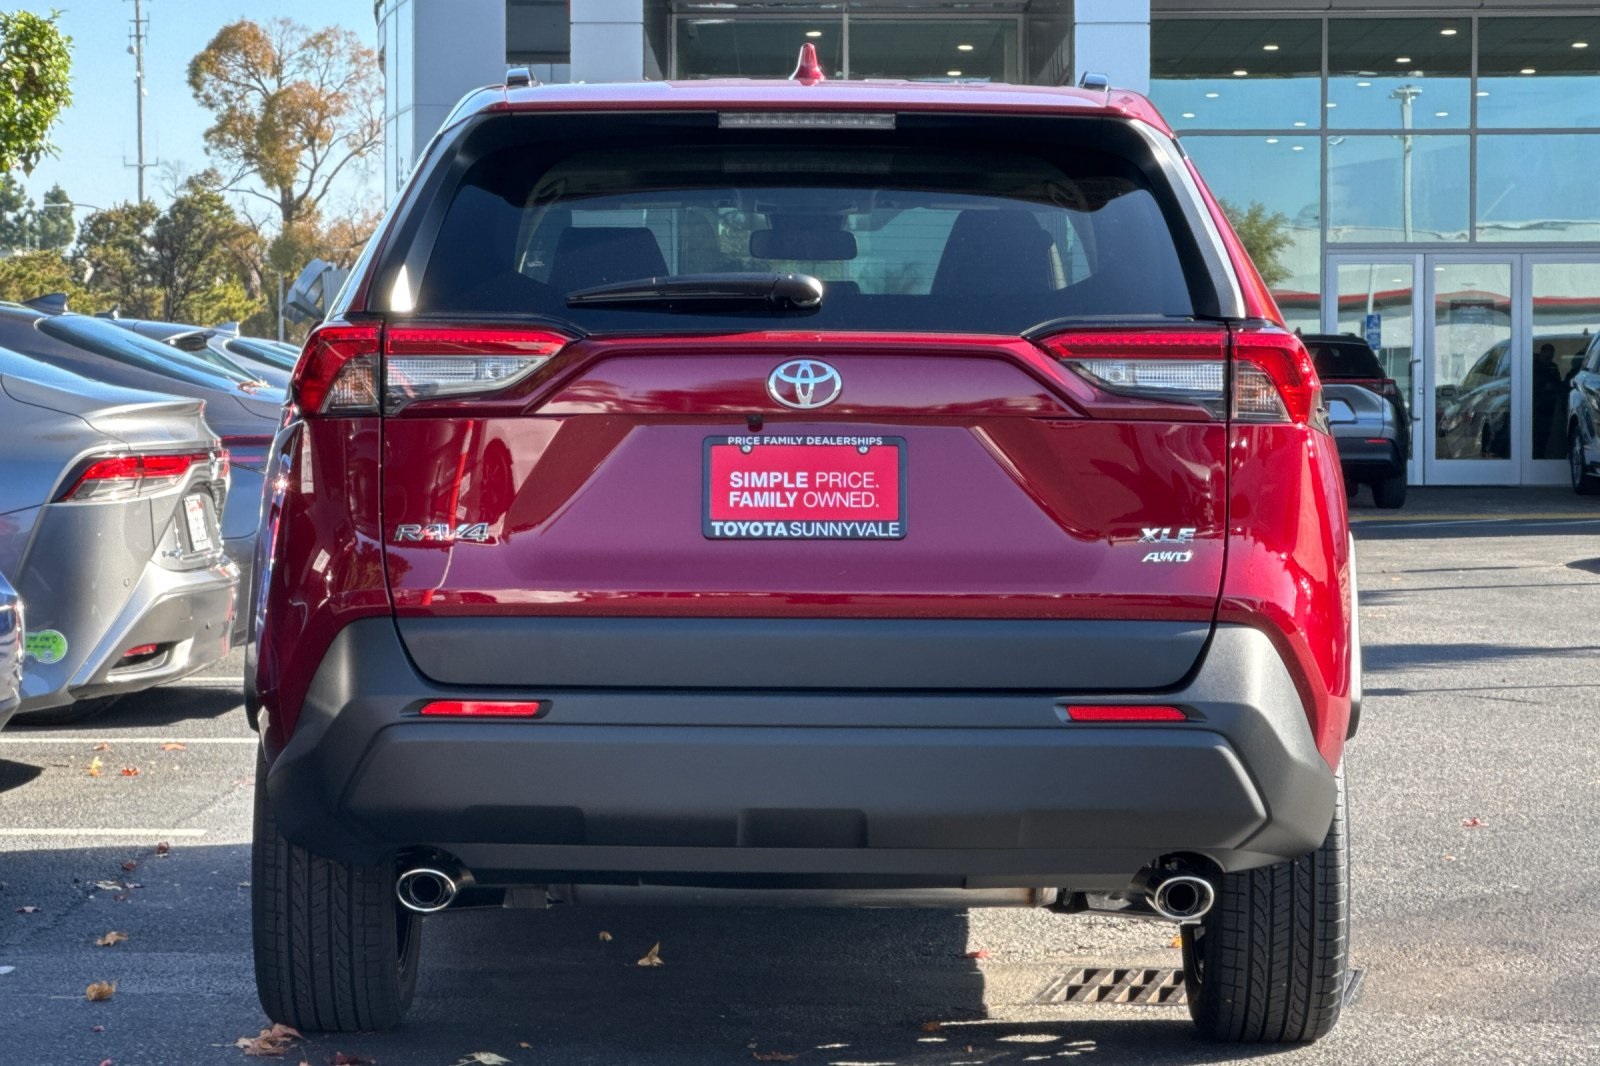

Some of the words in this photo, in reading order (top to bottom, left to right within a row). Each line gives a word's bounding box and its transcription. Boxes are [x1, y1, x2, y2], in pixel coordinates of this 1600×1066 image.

[728, 437, 760, 445] PRICE
[764, 437, 803, 445] FAMILY
[806, 437, 883, 445] DEALERSHIPS
[729, 472, 808, 488] SIMPLE
[815, 472, 880, 488] PRICE.
[729, 491, 798, 508] FAMILY
[803, 491, 880, 508] OWNED.
[394, 523, 489, 541] RAV4
[711, 522, 789, 536] TOYOTA
[789, 522, 900, 537] SUNNYVALE
[1137, 528, 1196, 543] XLE
[1140, 549, 1194, 563] AWD
